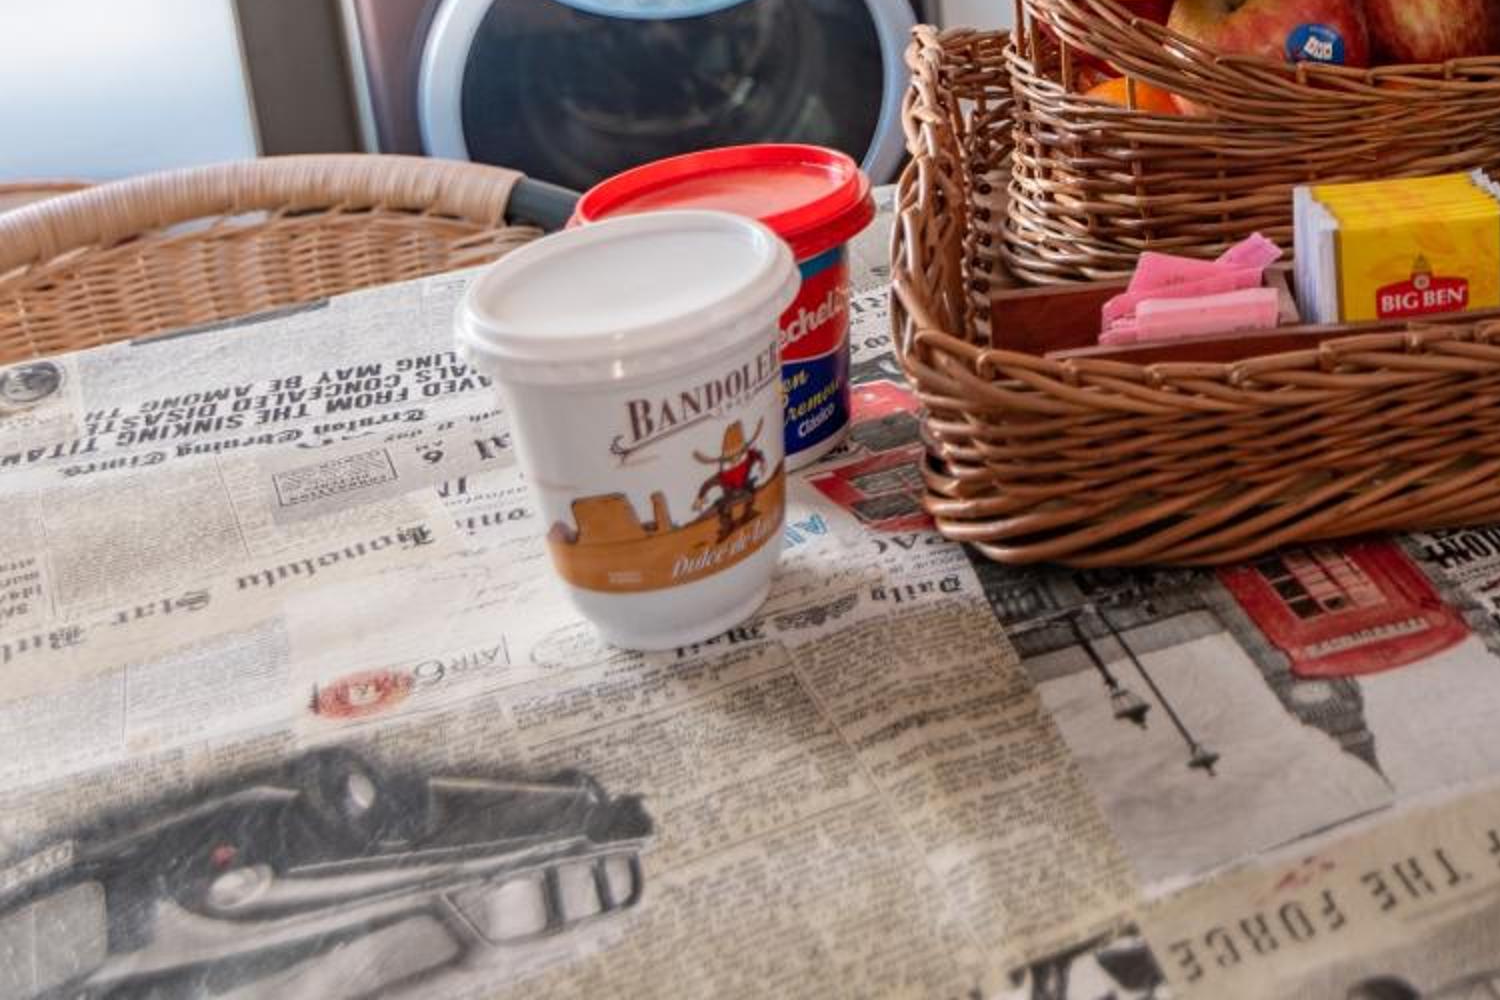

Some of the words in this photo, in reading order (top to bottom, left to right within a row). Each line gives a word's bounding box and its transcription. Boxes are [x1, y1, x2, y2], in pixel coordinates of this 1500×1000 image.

[1381, 291, 1419, 313] BIG
[1423, 285, 1463, 307] BEN
[1361, 848, 1471, 911] THE
[1170, 890, 1347, 984] FORCE
